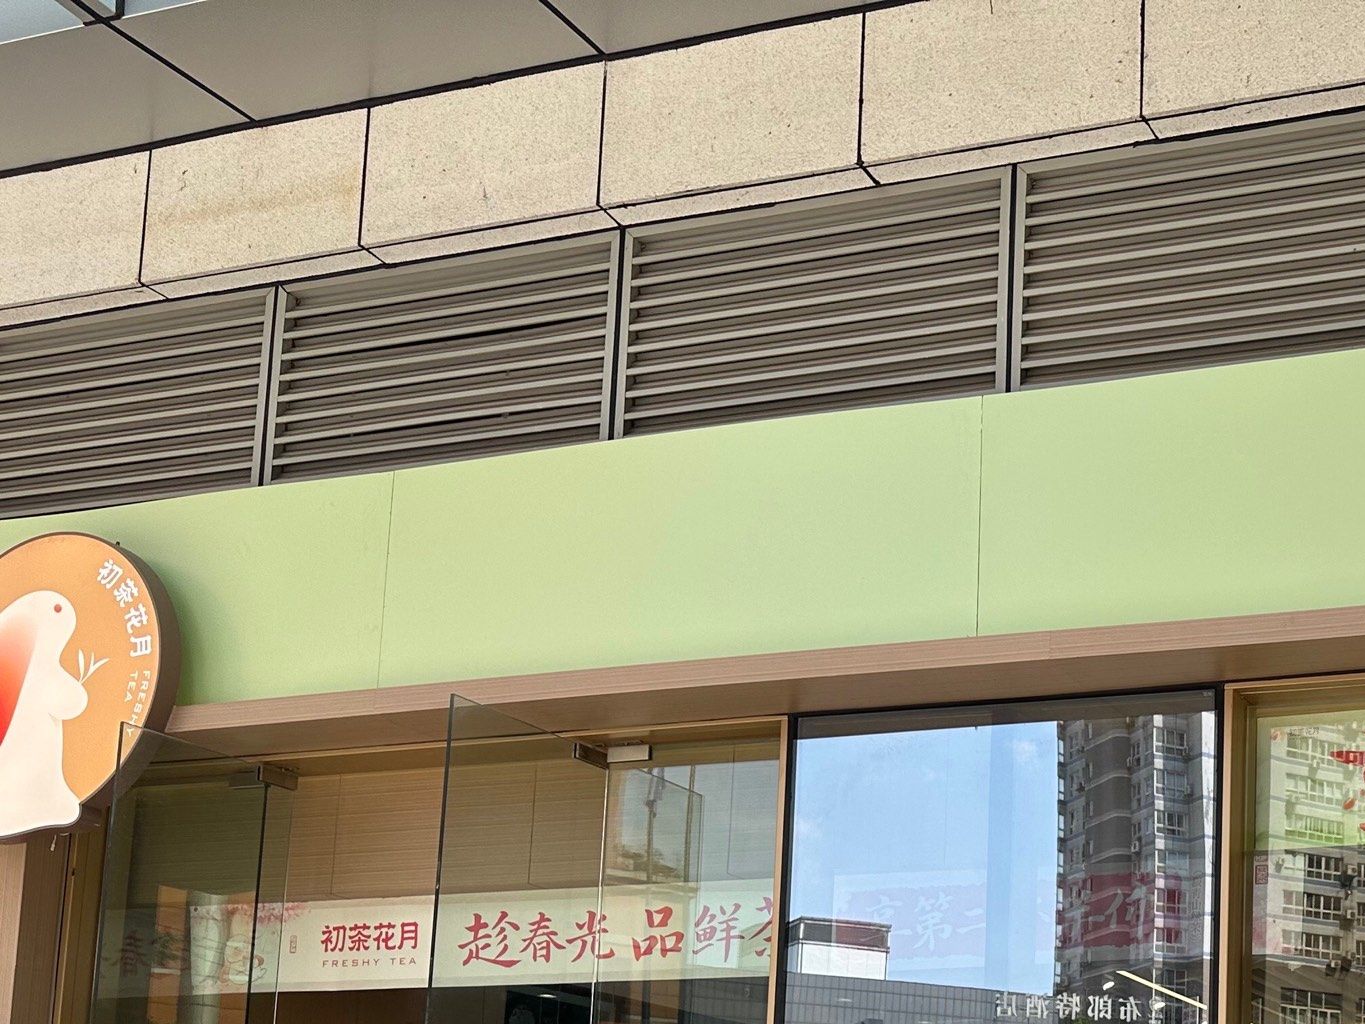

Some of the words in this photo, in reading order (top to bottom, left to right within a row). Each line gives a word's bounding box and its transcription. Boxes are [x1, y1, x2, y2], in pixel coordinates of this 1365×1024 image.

[97, 559, 152, 657] 初茶花月
[125, 671, 138, 703] TEA
[127, 670, 151, 737] FRESHY
[320, 921, 420, 953] 初茶花月
[457, 910, 615, 968] 趁春光
[322, 958, 380, 968] FRESHY
[390, 957, 417, 966] TEA
